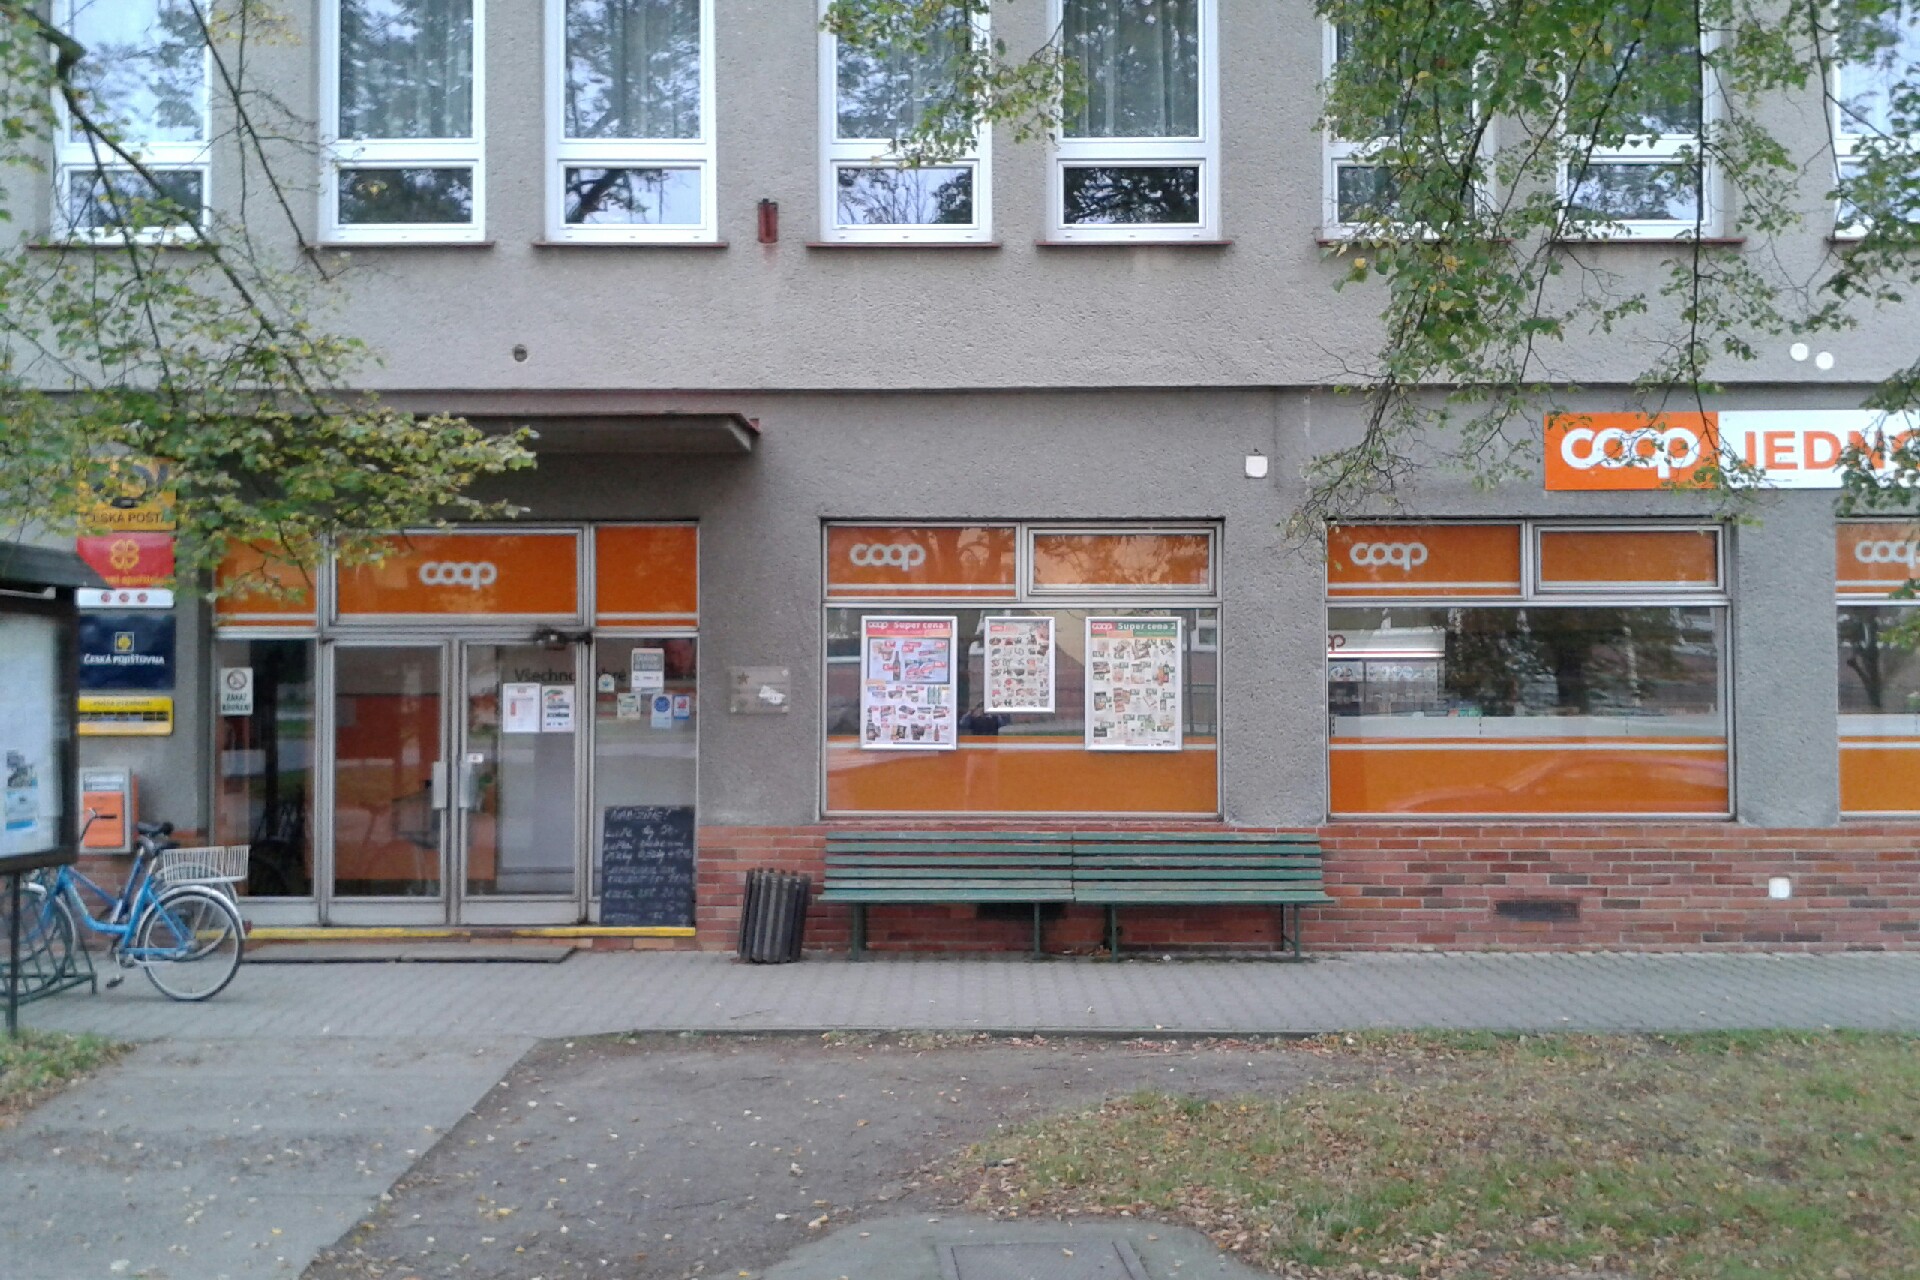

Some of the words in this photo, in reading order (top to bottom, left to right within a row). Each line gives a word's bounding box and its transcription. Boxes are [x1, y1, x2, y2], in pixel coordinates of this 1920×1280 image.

[1561, 427, 1700, 479] coop
[849, 543, 926, 571] coop
[1350, 542, 1428, 571] coop
[419, 561, 497, 591] coop
[893, 622, 920, 630] Super
[1117, 622, 1145, 630] Super
[1147, 622, 1169, 630] cena
